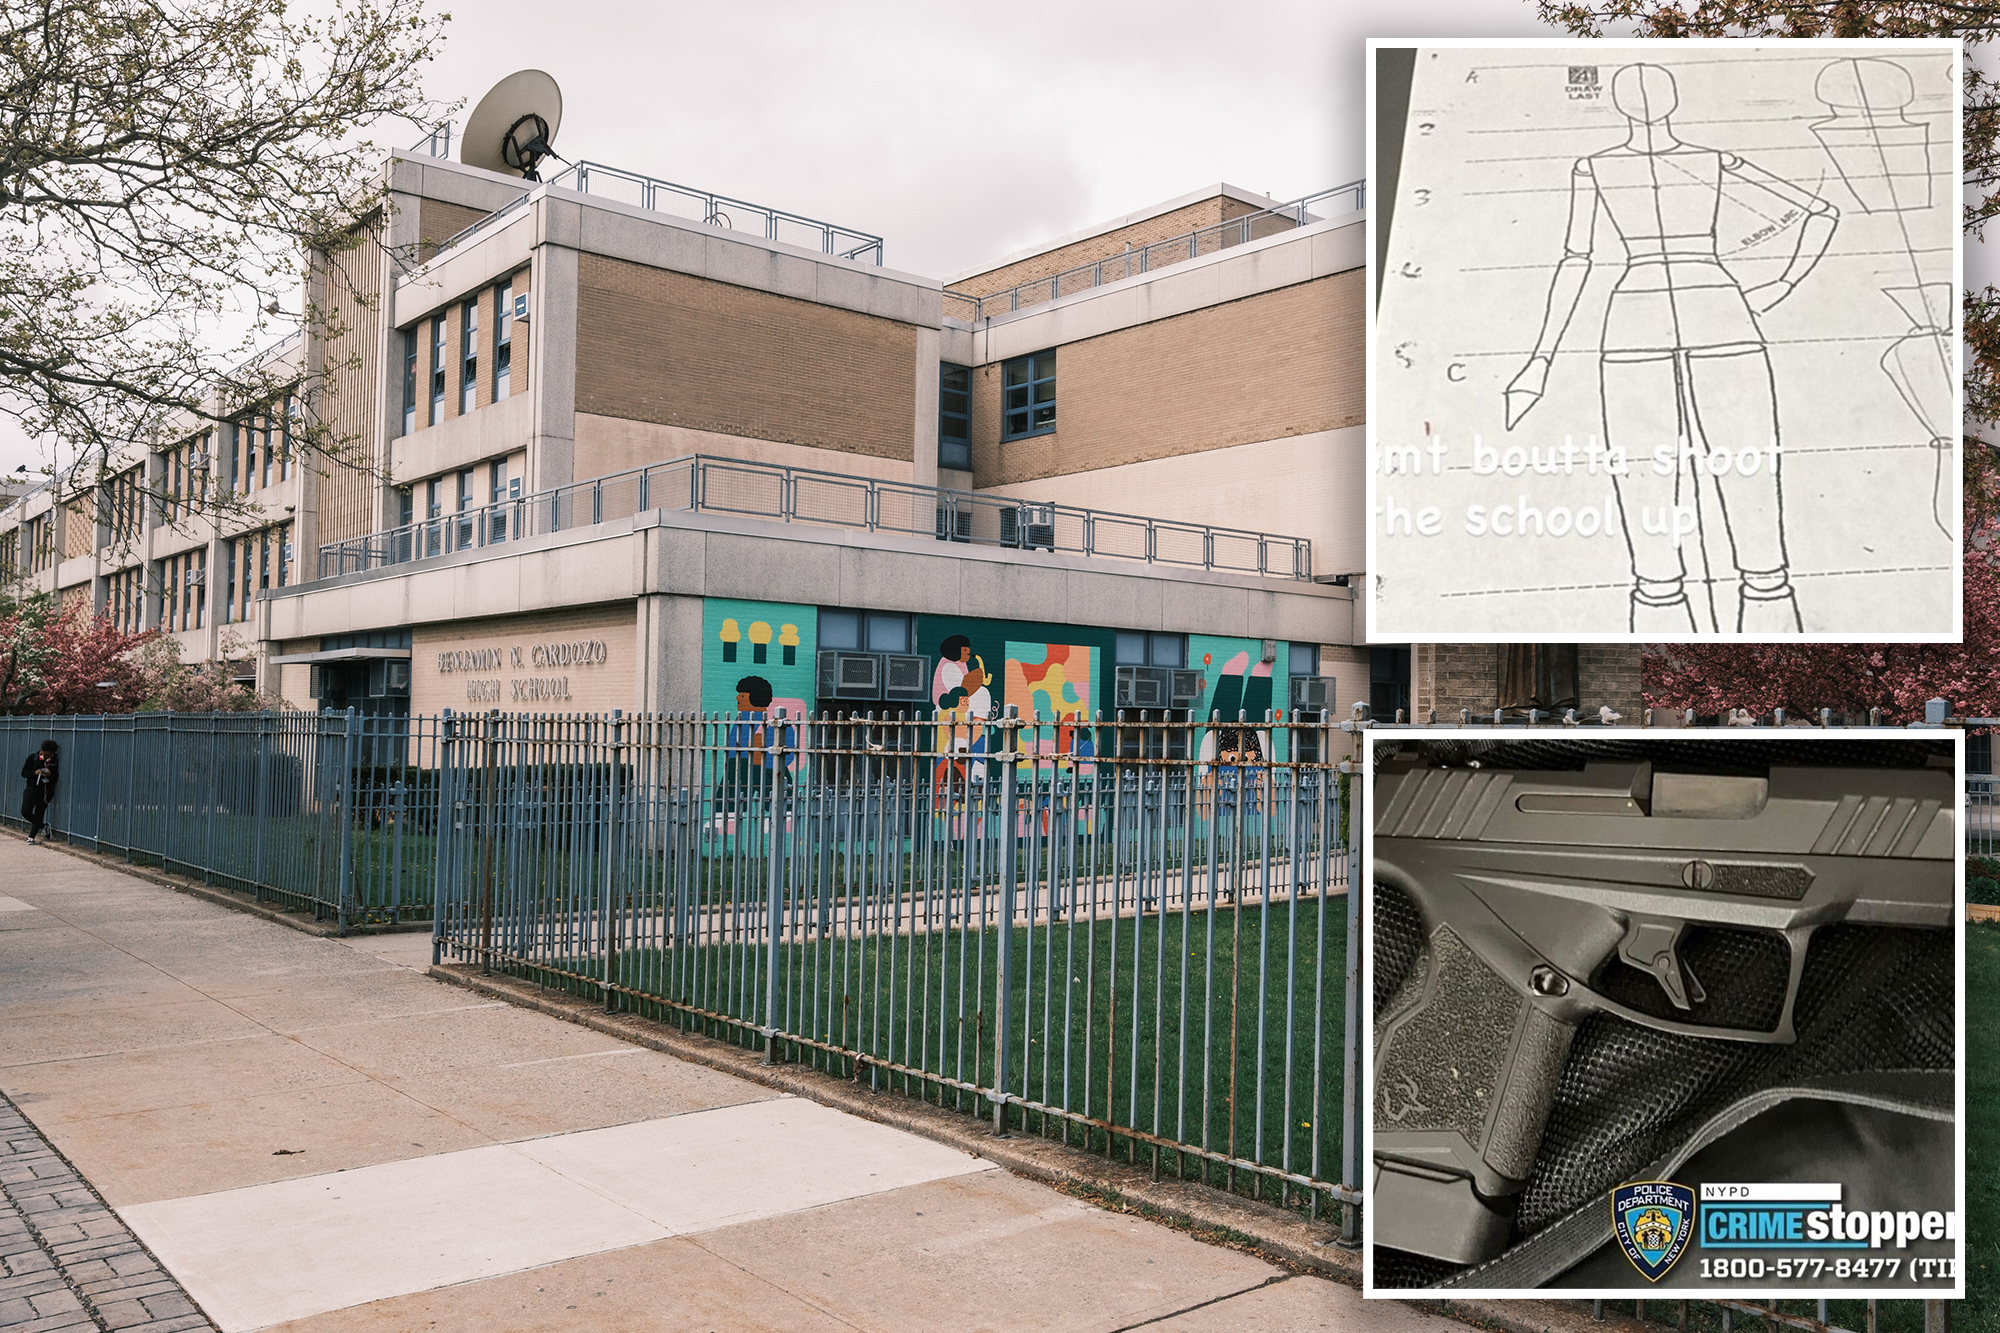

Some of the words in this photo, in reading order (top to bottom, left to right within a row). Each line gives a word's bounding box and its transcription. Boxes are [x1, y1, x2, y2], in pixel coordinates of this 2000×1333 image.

[1564, 85, 1603, 93] DRAW
[1740, 224, 1777, 246] ELBOW
[1780, 208, 1799, 224] ARC
[1447, 363, 1467, 382] C
[437, 648, 502, 673] BENJAMIN
[530, 638, 608, 668] CARDOZO
[466, 678, 501, 702] HIGH
[510, 675, 571, 702] SCHOOL
